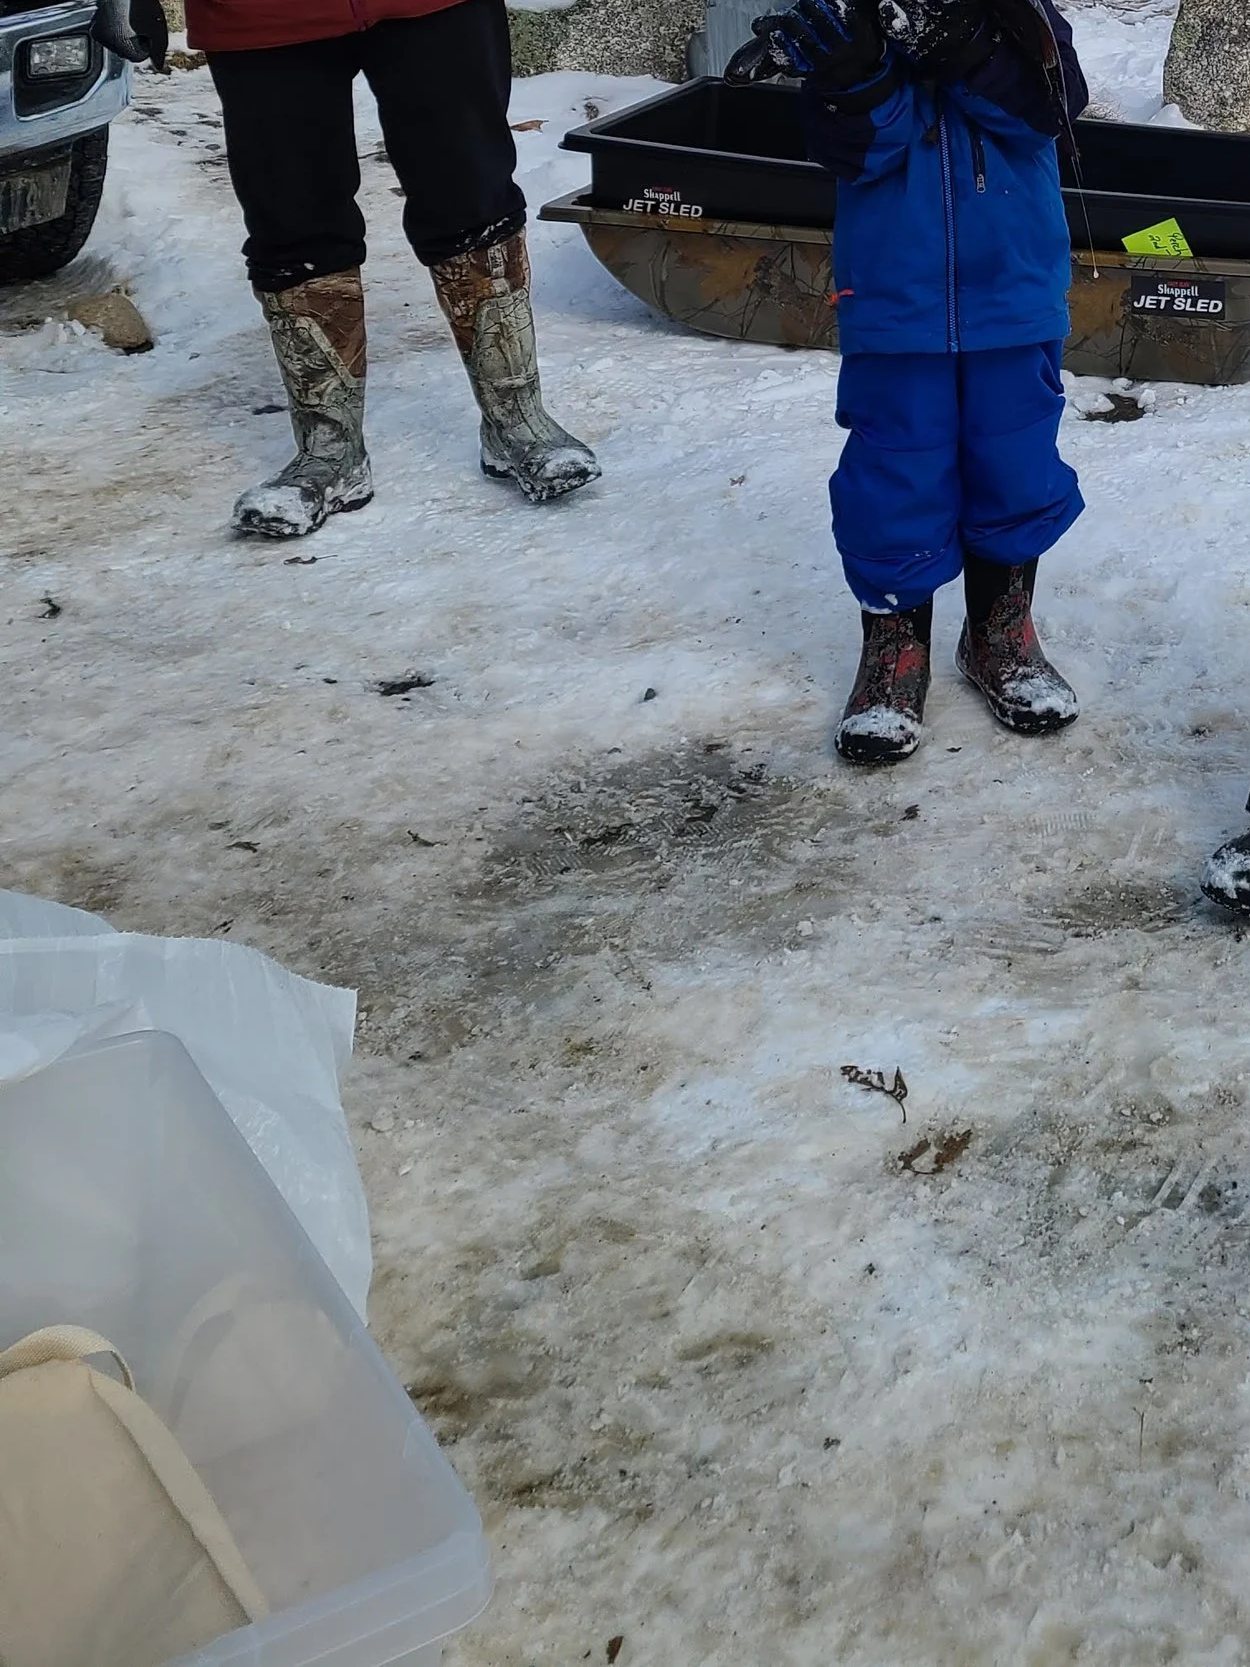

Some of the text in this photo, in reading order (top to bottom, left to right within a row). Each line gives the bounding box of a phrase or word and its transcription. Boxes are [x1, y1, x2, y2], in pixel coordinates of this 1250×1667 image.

[623, 198, 703, 218] JET SLED
[1133, 295, 1223, 313] JET SLED
